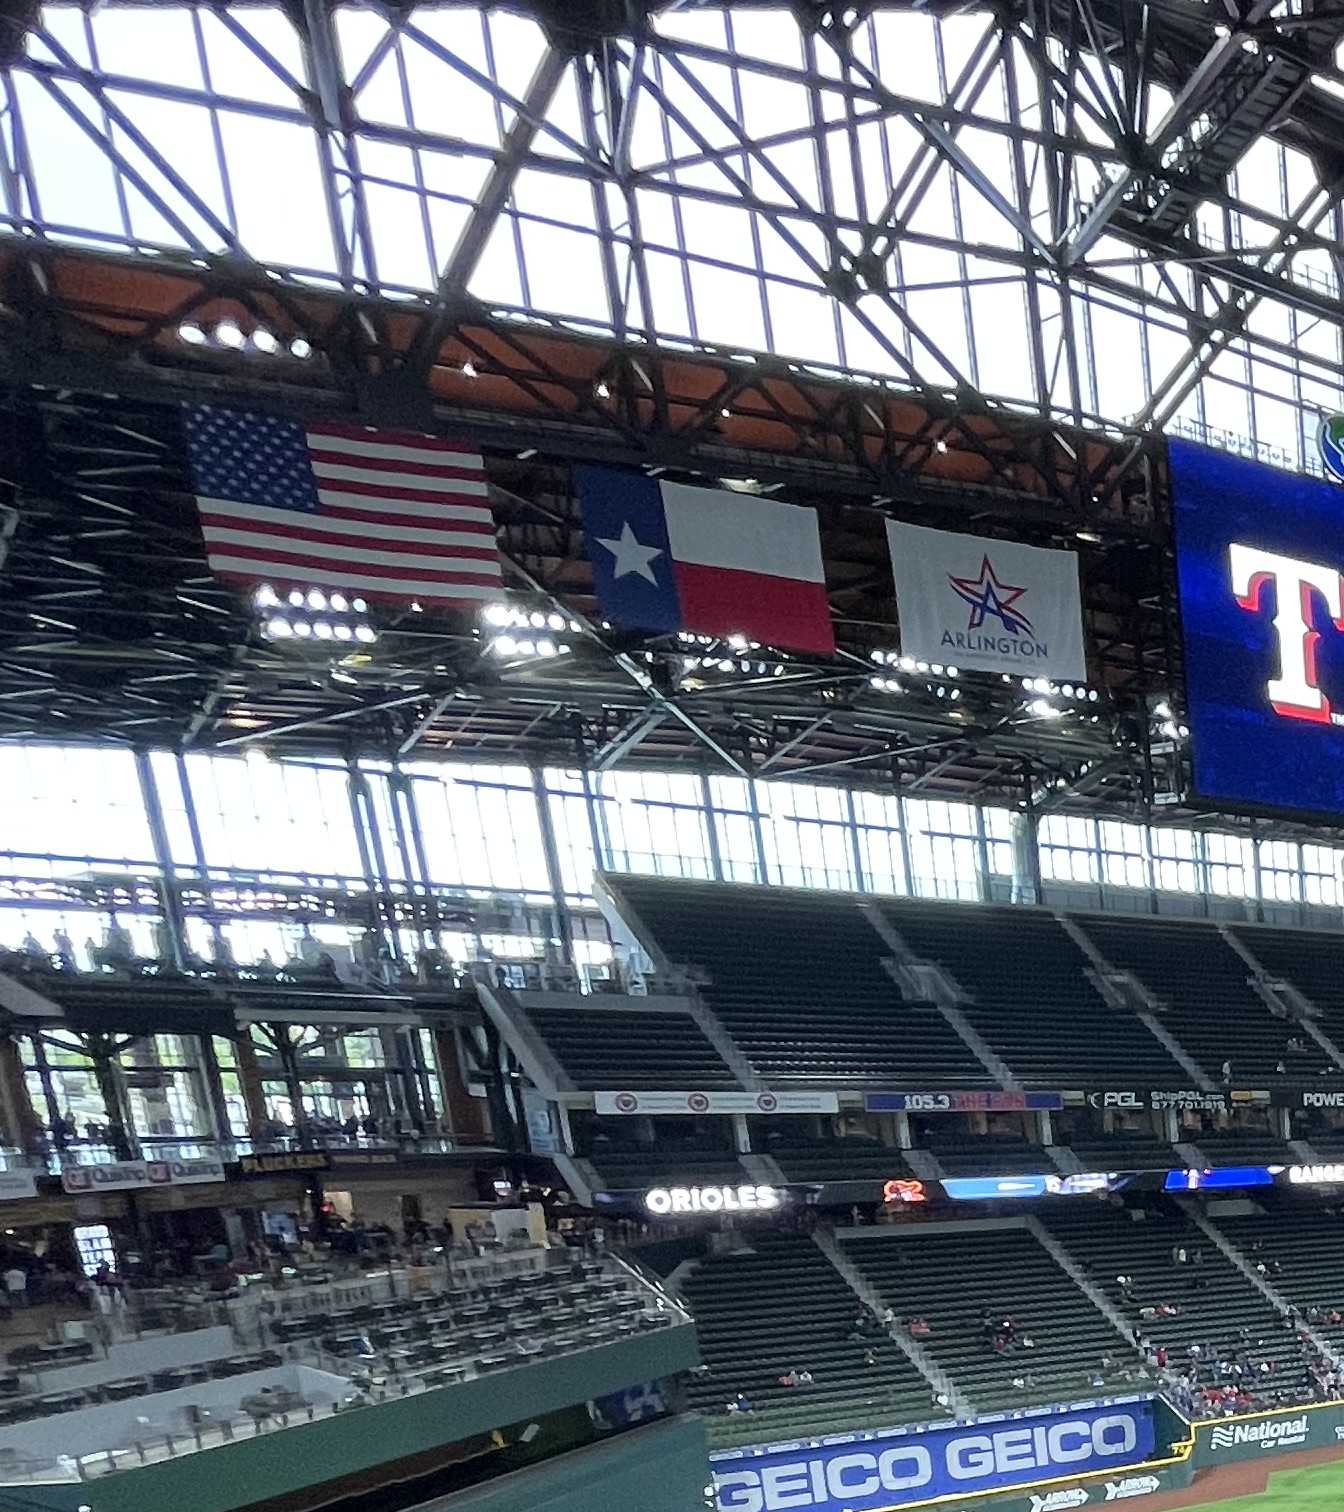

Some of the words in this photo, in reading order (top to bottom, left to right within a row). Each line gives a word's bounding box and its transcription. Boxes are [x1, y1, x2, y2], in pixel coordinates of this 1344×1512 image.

[941, 629, 1048, 658] ARLINGTON
[904, 1094, 950, 1109] 105.3
[1104, 1091, 1144, 1107] PGL
[646, 1186, 778, 1213] ORIOLES
[1234, 1415, 1310, 1444] National
[946, 1413, 1137, 1480] GEICO
